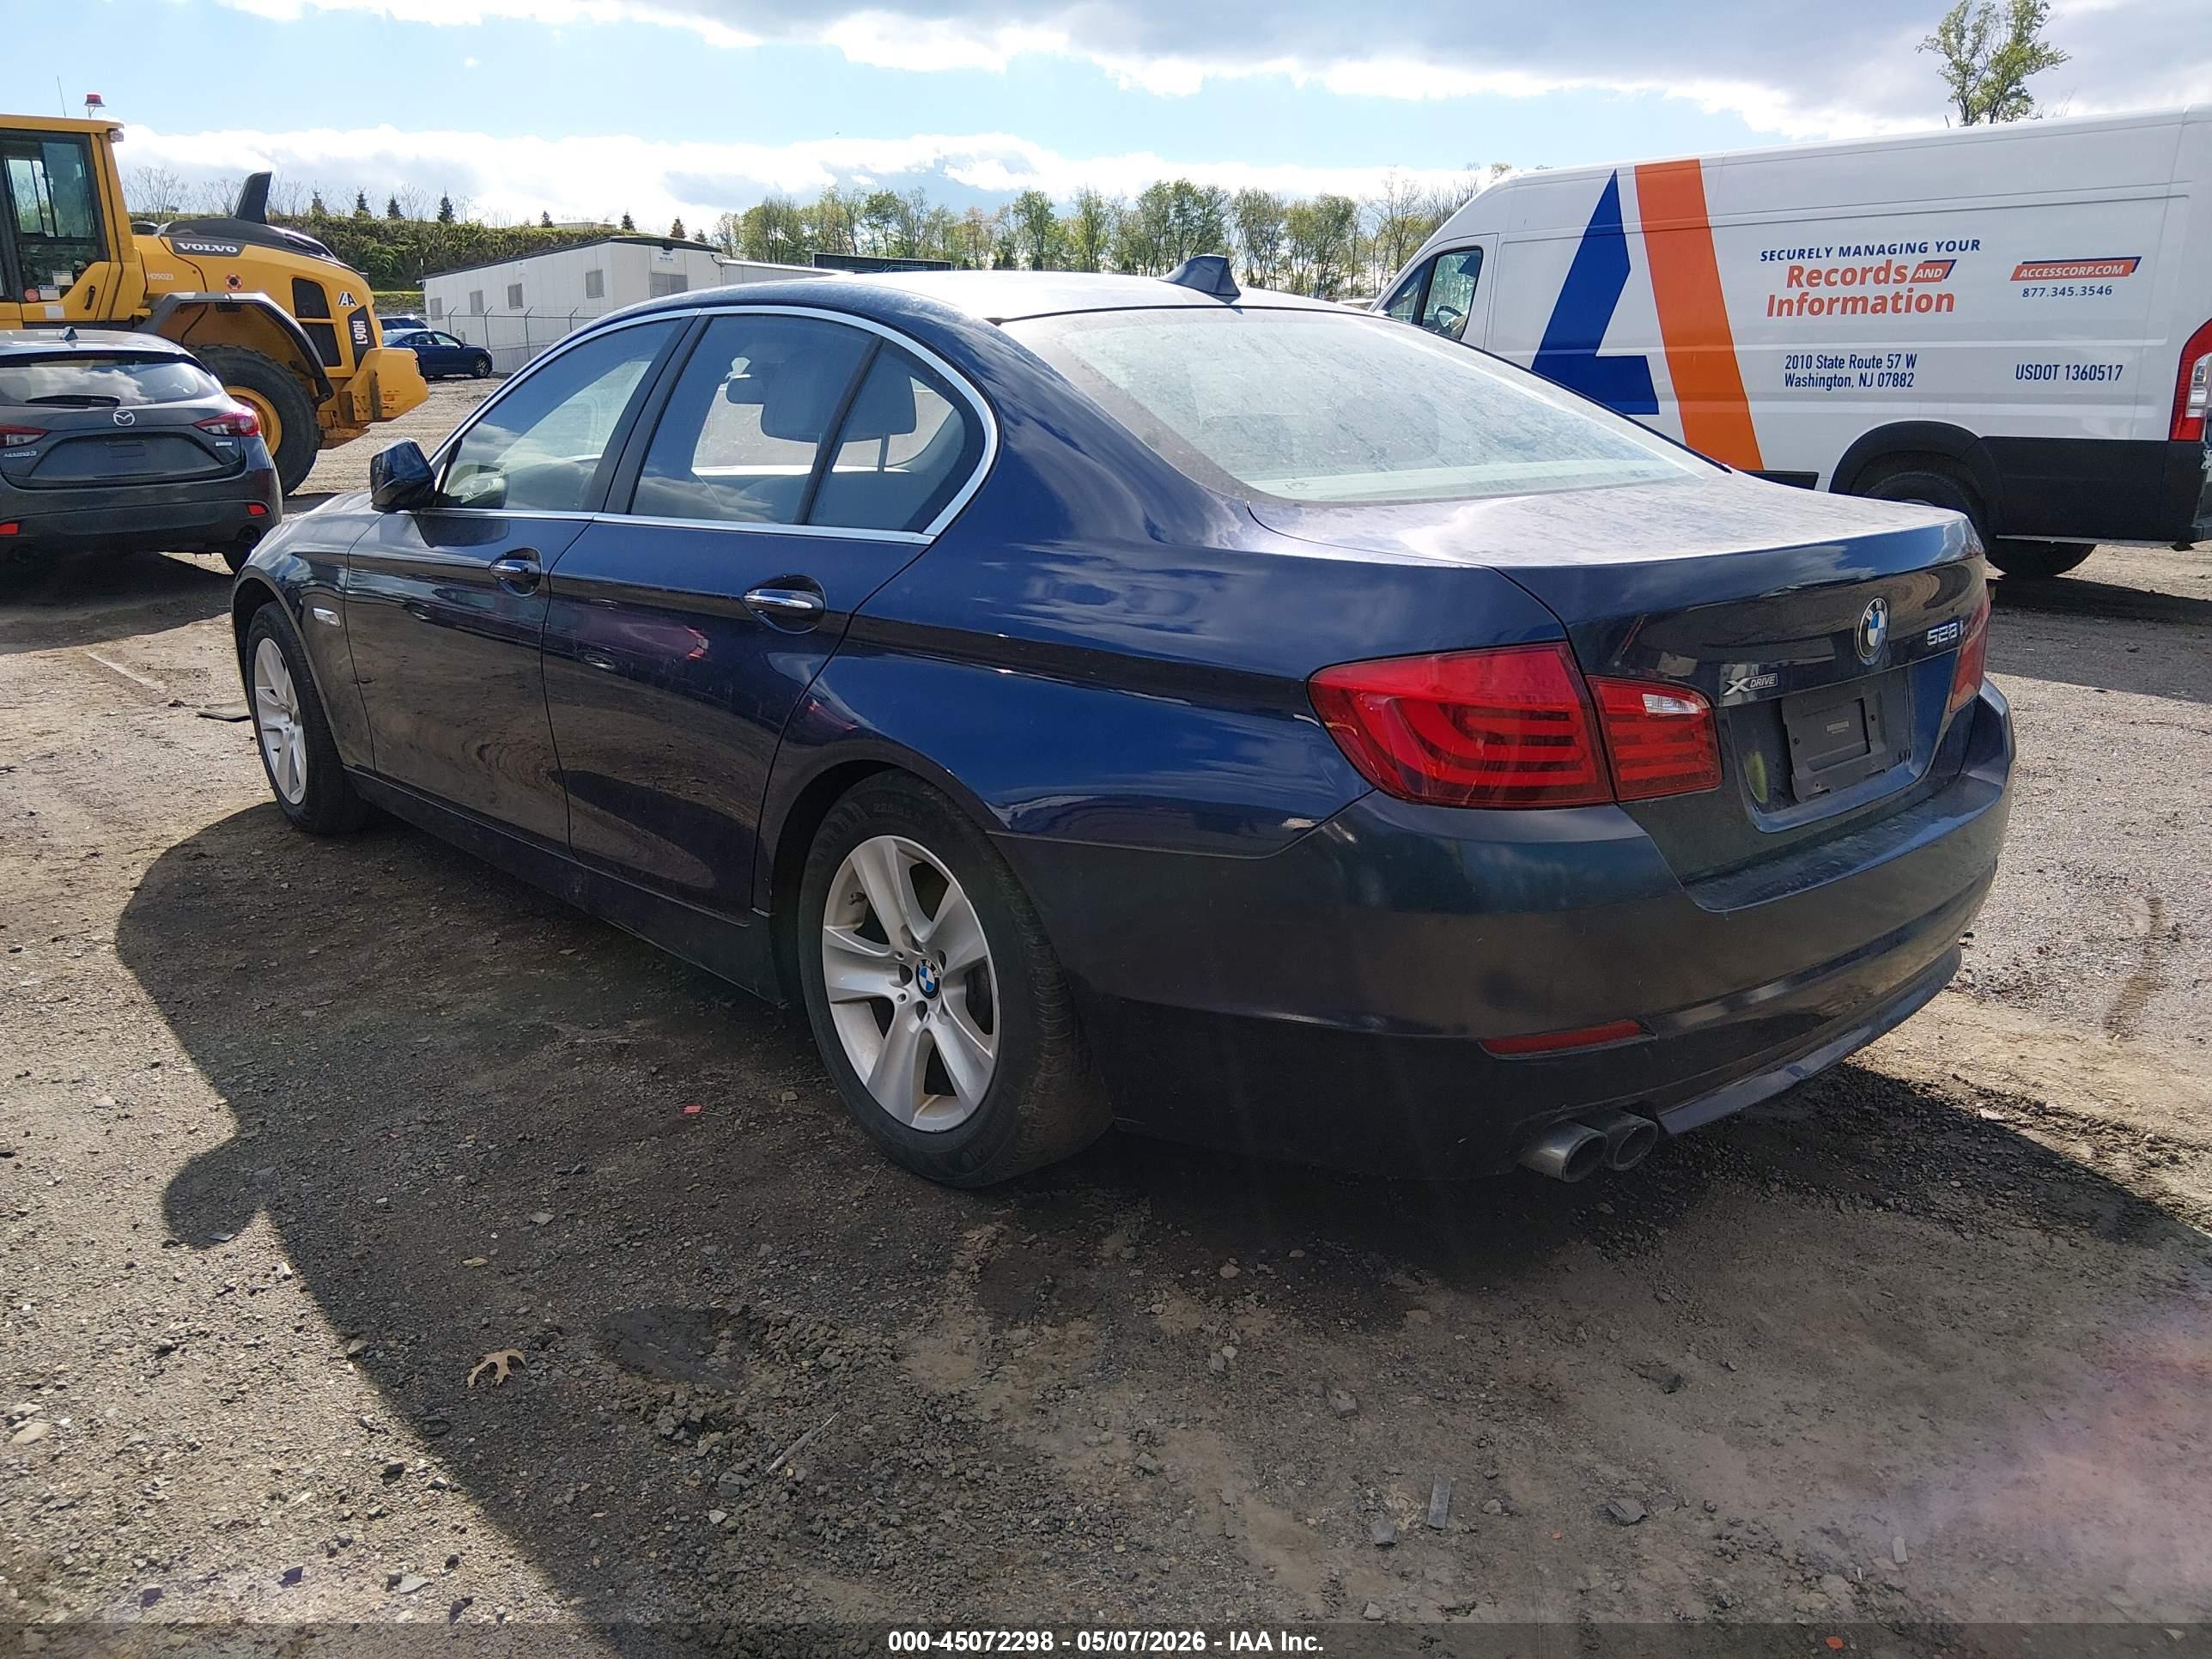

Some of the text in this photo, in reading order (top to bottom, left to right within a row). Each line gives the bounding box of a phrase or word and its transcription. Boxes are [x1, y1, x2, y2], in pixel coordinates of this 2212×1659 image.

[177, 242, 238, 253] VOLVO
[1760, 239, 1981, 262] SECURELY MANAGING YOUR
[1786, 259, 1943, 289] Records AND
[2019, 264, 2124, 278] ACCESSCORP.COM
[2021, 285, 2112, 298] 877.345.3546
[1765, 288, 1955, 318] Information
[1784, 353, 1917, 369] 2010 State Route 57 W
[2015, 364, 2124, 381] USDOT 1360517
[1784, 372, 1915, 392] Washington, NJ 07882
